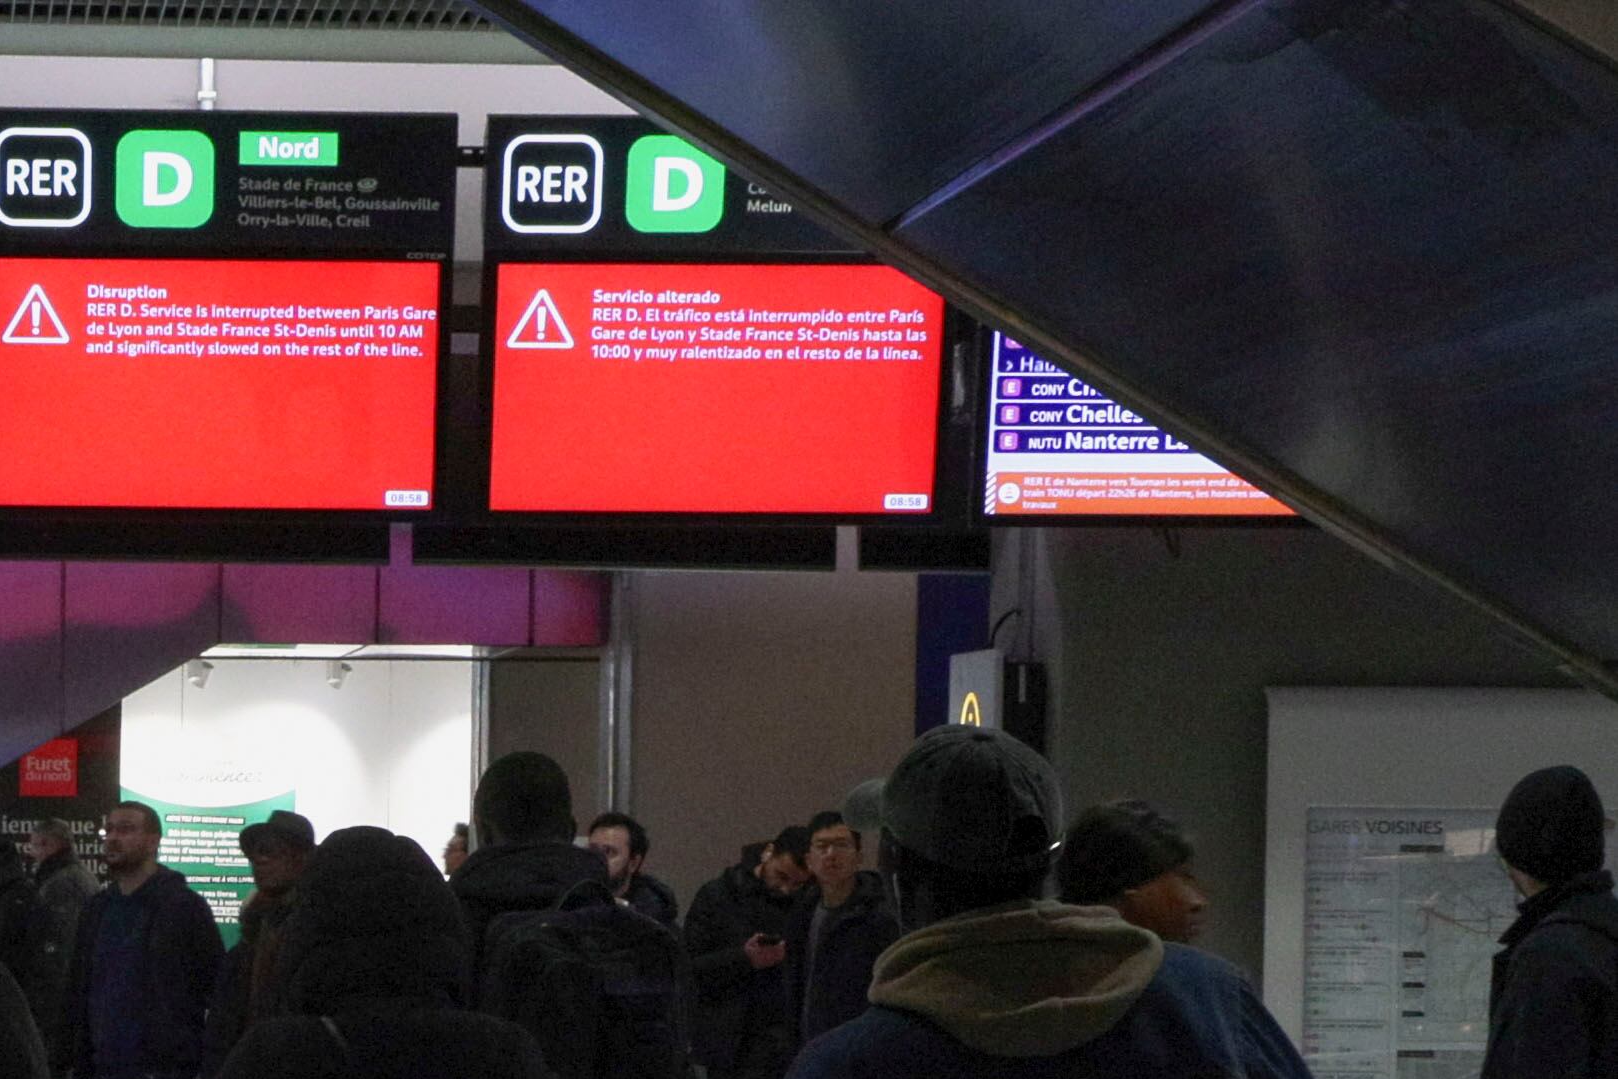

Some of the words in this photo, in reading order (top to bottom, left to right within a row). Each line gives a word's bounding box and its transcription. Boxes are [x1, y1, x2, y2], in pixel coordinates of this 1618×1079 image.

[258, 136, 319, 159] Nord
[6, 158, 77, 197] RER
[143, 151, 193, 206] D
[238, 177, 280, 190] Stade
[283, 178, 301, 191] de
[305, 178, 353, 192] France
[516, 165, 589, 203] RER
[653, 157, 703, 211] D
[238, 195, 342, 211] Villiers-le-Bel,
[345, 197, 440, 211] Goussainville
[237, 213, 332, 228] Orry-la-Ville,
[336, 214, 370, 228] Creil
[87, 284, 168, 301] Disruption
[592, 289, 654, 303] Servicio
[656, 290, 721, 303] alterado
[86, 303, 117, 317] RER
[119, 303, 138, 317] D.
[139, 304, 193, 317] Service
[195, 304, 209, 318] is
[211, 305, 294, 320] interrupted
[297, 305, 361, 319] between
[364, 306, 400, 319] Paris
[402, 306, 437, 320] Gare
[591, 308, 623, 321] RER
[625, 308, 642, 321] D.
[645, 308, 661, 321] El
[663, 308, 712, 322] tráfico
[714, 309, 746, 322] está
[748, 309, 844, 325] interrumpido
[846, 311, 887, 323] entre
[889, 309, 925, 323] París
[86, 322, 106, 335] de
[108, 322, 143, 338] Lyon
[145, 323, 174, 336] and
[176, 322, 219, 336] Stade
[221, 323, 271, 336] France
[273, 323, 337, 337] St-Denis
[339, 324, 375, 337] until
[377, 324, 396, 338] 10
[398, 325, 423, 337] AM
[85, 340, 114, 353] and
[116, 340, 205, 357] significantly
[207, 341, 260, 355] slowed
[262, 345, 282, 355] on
[284, 343, 310, 355] the
[312, 344, 342, 356] rest
[344, 343, 362, 355] of
[363, 343, 389, 356] the
[391, 343, 423, 356] line.
[1007, 381, 1017, 394] E
[1031, 384, 1065, 396] CONY
[1005, 408, 1015, 421] E
[1029, 410, 1063, 423] CONY
[1003, 435, 1014, 448] E
[1028, 437, 1062, 450] NUTU
[1065, 431, 1160, 450] Nanterre
[26, 755, 71, 771] Furet
[25, 770, 42, 781] du
[43, 769, 72, 782] nord
[1309, 819, 1359, 834] GARES
[1365, 819, 1443, 835] VOISINES
